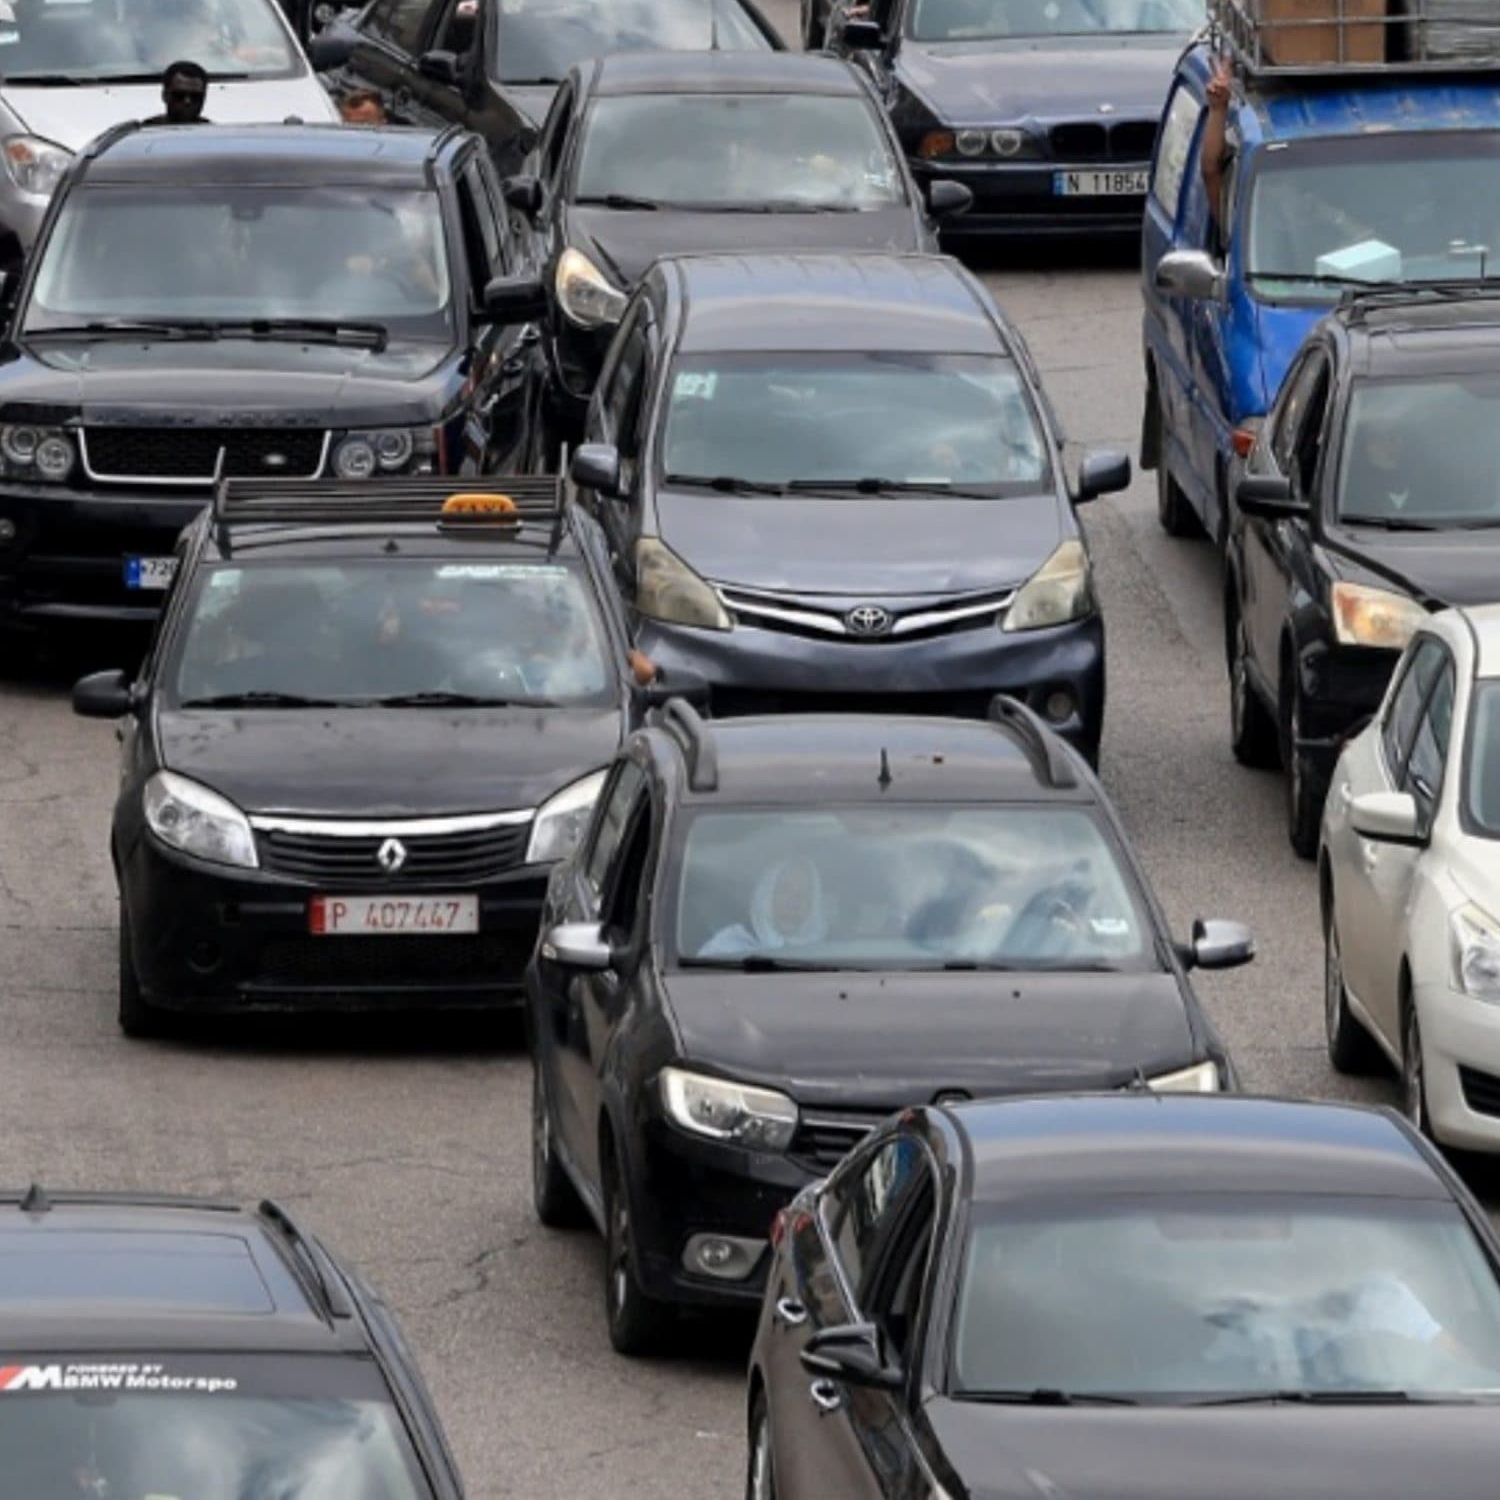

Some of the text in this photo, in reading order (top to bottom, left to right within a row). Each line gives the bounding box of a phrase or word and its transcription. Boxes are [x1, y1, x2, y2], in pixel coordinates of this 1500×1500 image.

[332, 902, 460, 929] P 407447
[66, 1364, 163, 1374] POWERED BY
[64, 1375, 238, 1392] BMW Motorspo
